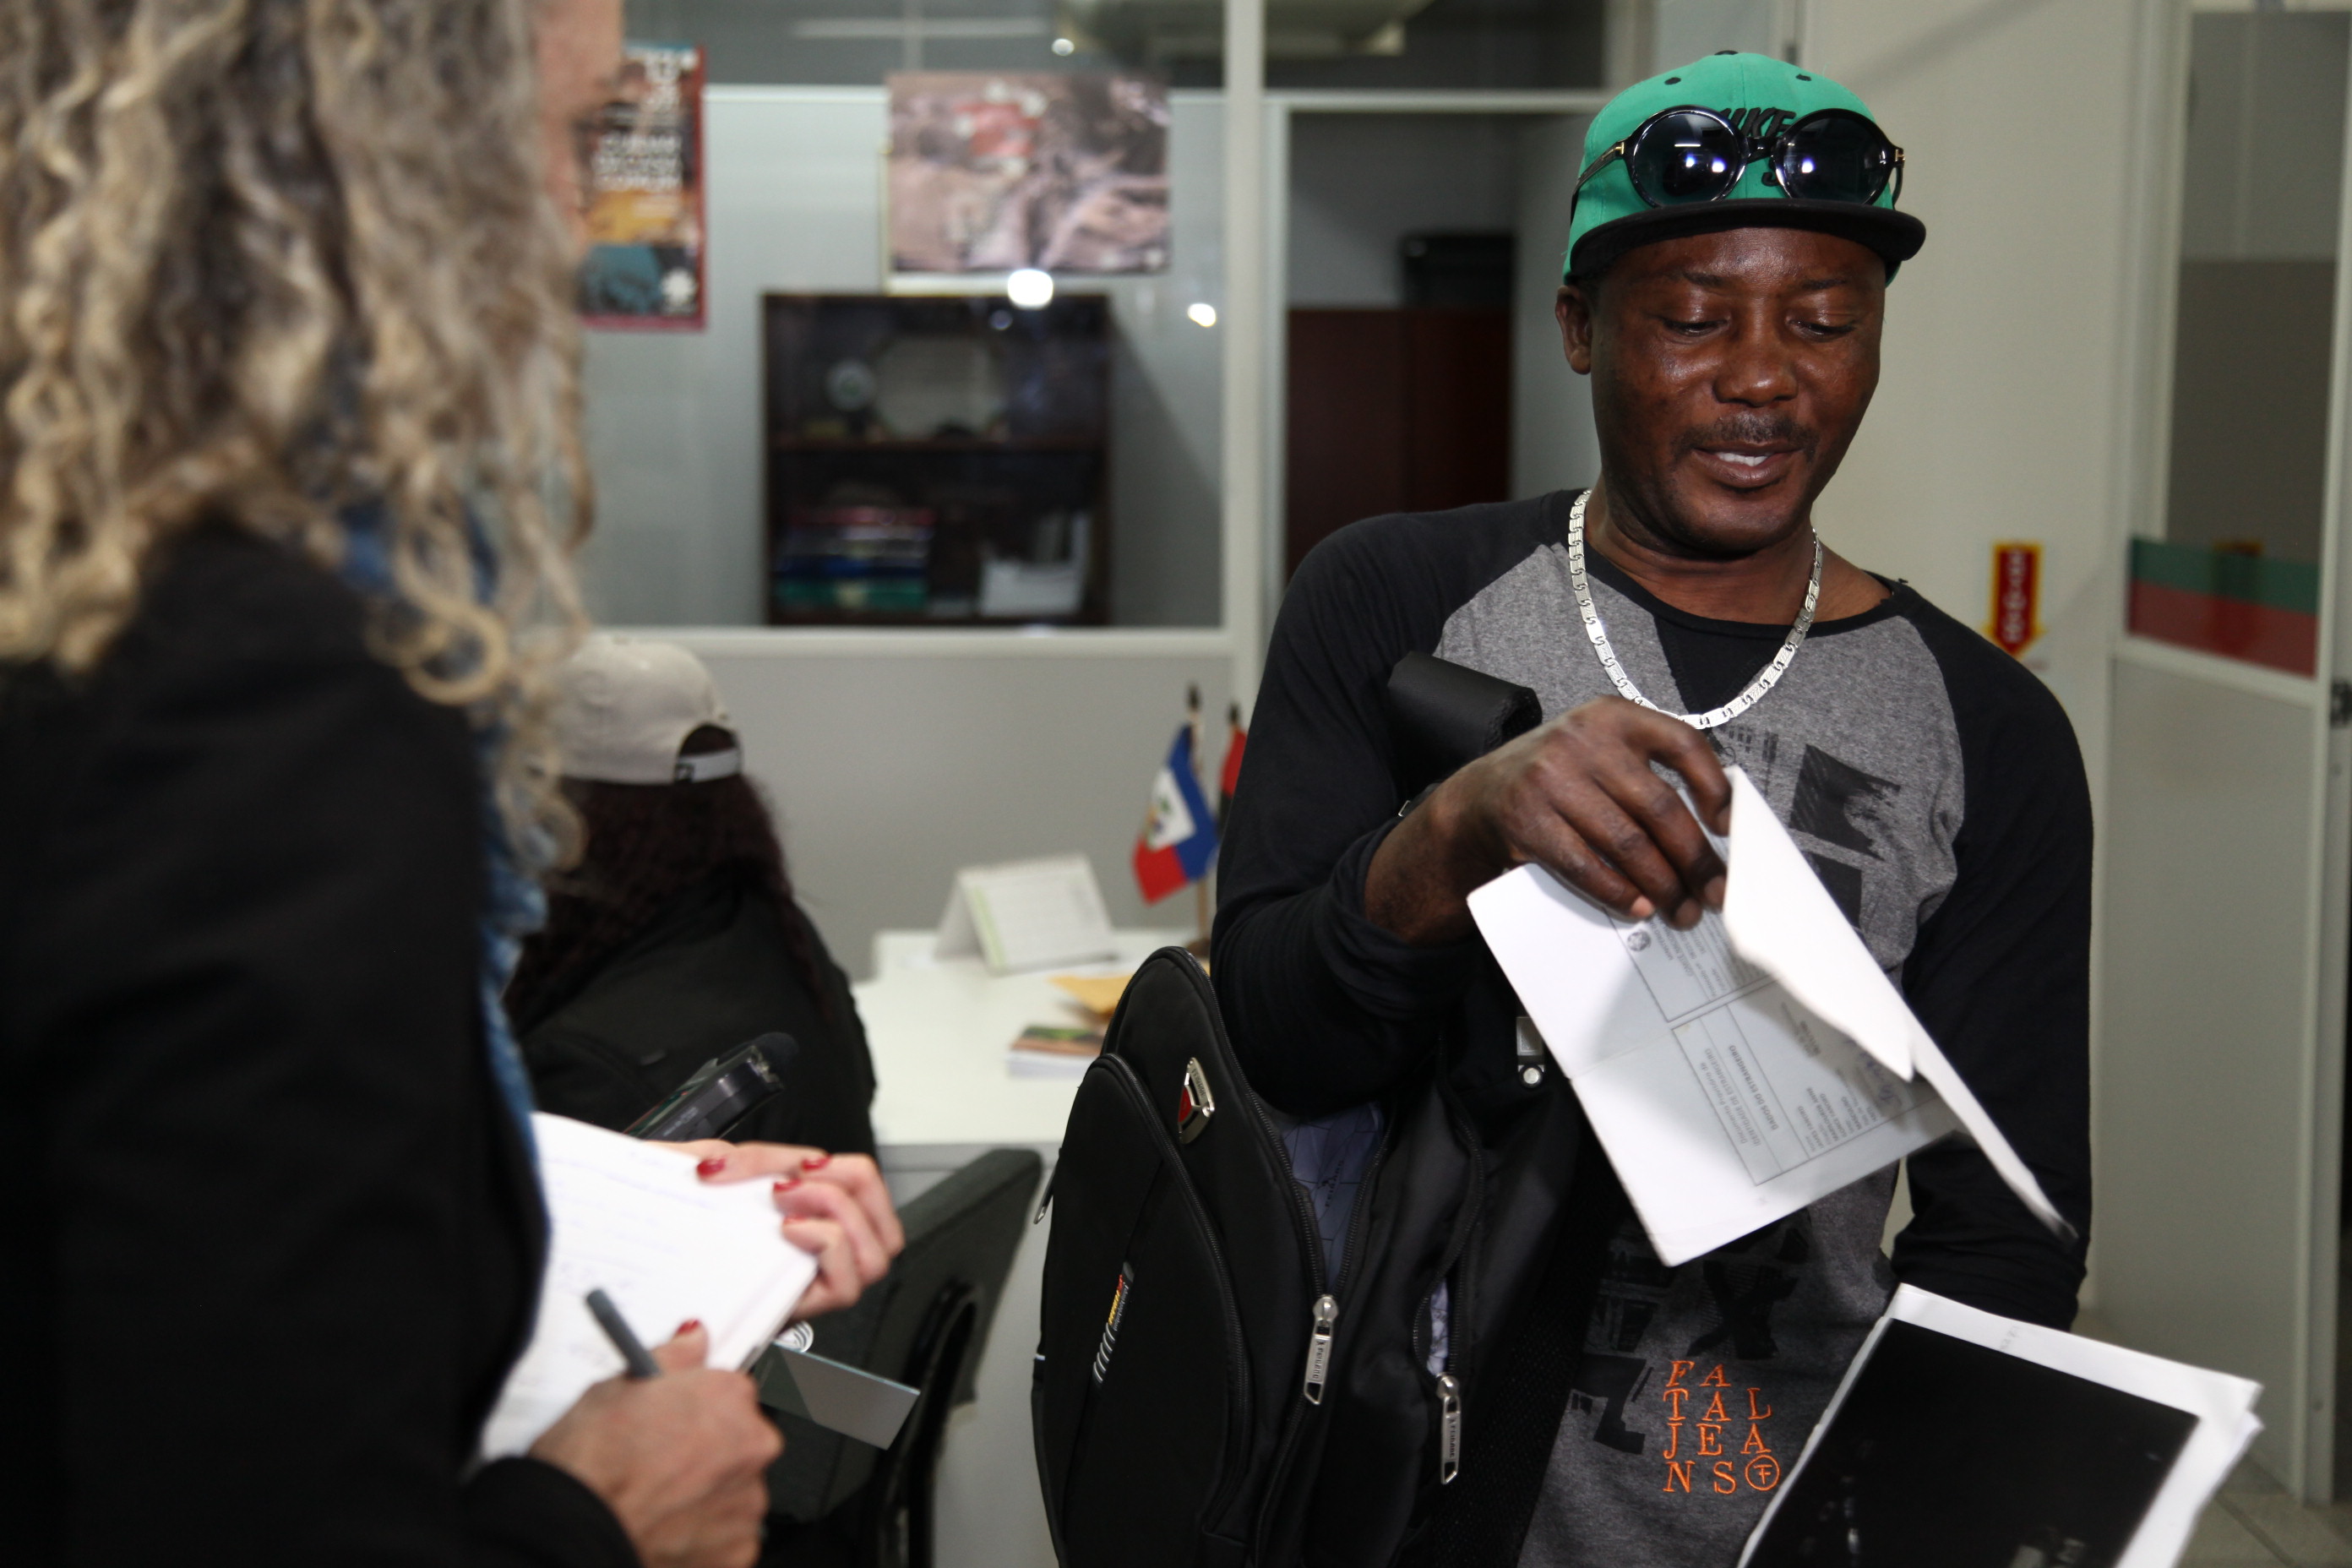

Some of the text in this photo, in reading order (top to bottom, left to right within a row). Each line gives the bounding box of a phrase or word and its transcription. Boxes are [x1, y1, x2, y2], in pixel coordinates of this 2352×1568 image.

[1703, 1047, 1734, 1096] ESTRANGEIRO
[1727, 1043, 1779, 1131] DADOS DO ESTRANGEIRO
[1734, 1104, 1761, 1146] IDENTIDADE
